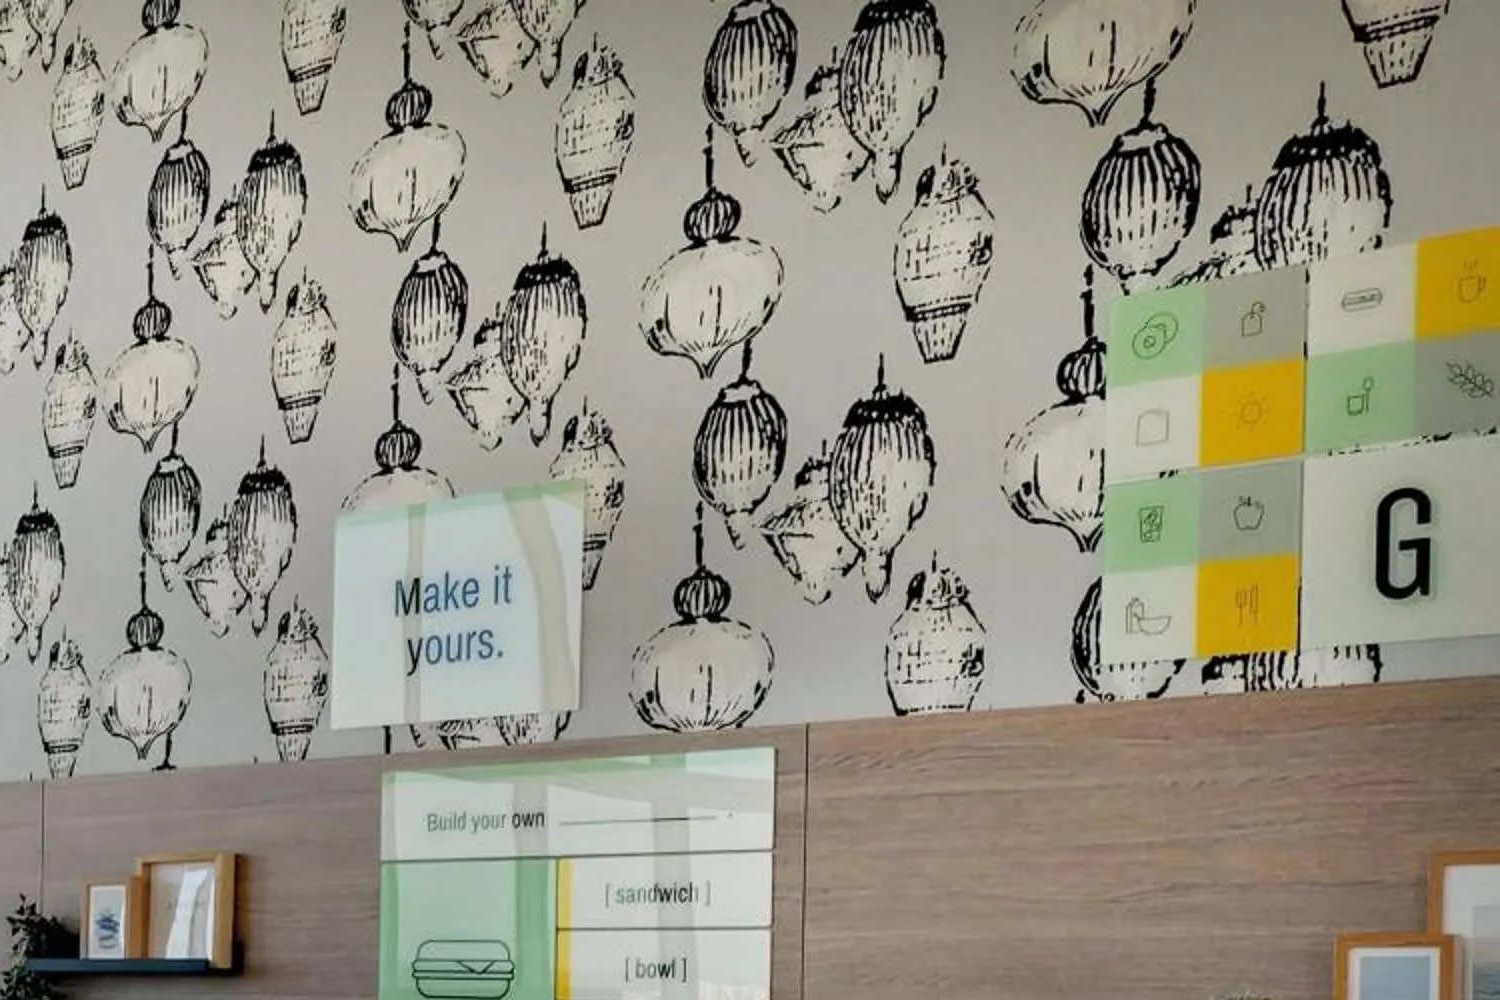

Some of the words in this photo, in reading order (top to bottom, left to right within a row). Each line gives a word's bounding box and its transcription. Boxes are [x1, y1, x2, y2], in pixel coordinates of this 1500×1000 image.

[1375, 487, 1432, 600] G
[394, 571, 480, 617] Make
[493, 564, 513, 606] it
[406, 629, 503, 677] yours.
[426, 811, 467, 832] Build
[471, 813, 507, 835] your
[511, 812, 545, 829] own
[615, 881, 699, 904] sandwich
[635, 958, 677, 979] bowl
